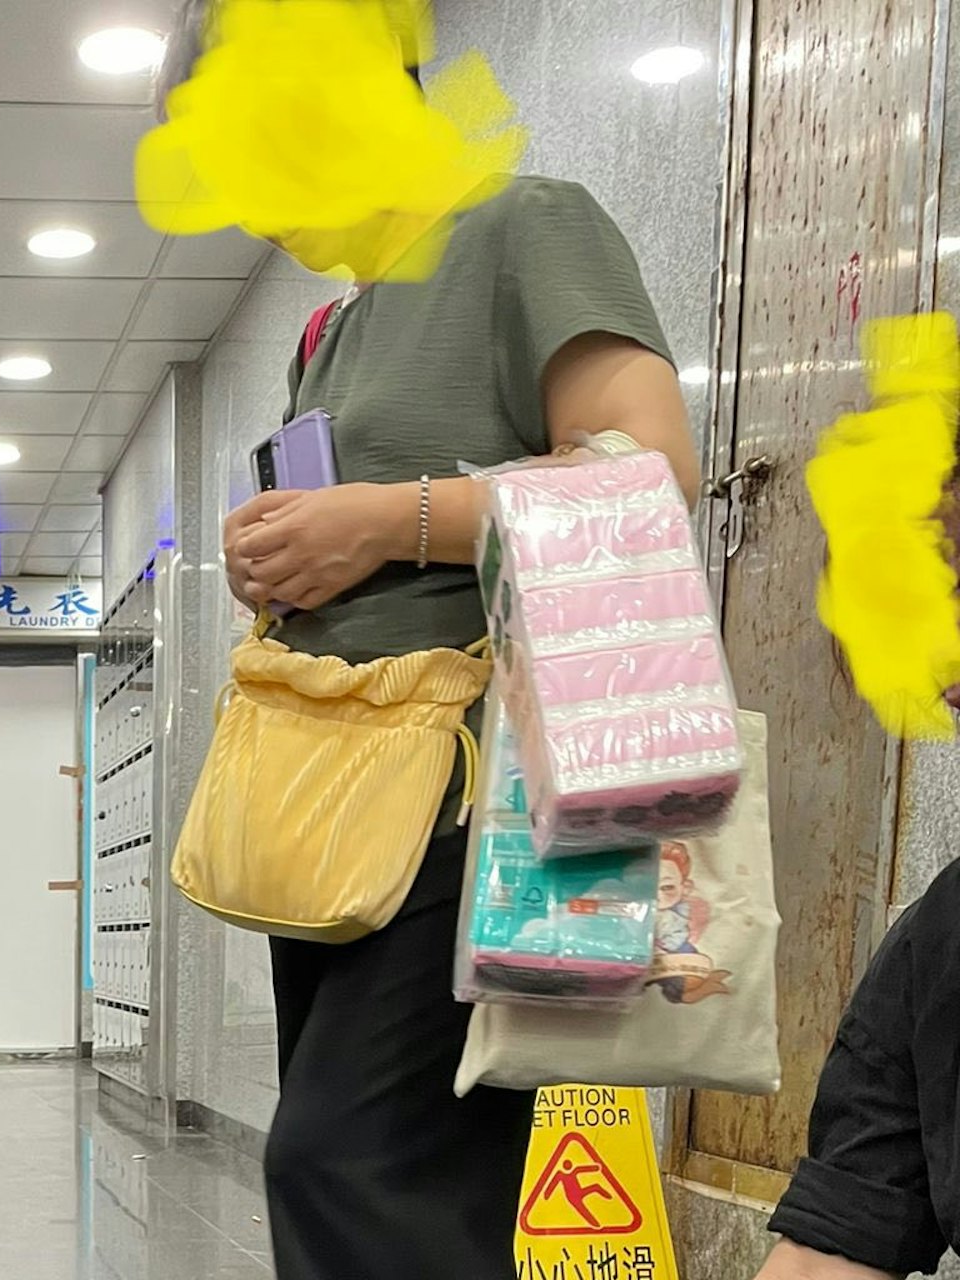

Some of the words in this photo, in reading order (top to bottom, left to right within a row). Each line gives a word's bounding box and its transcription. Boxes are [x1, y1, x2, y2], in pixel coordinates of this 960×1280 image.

[9, 616, 79, 627] LAUNDRY
[537, 1088, 616, 1107] AUTION
[533, 1109, 557, 1128] ET
[562, 1108, 630, 1127] FLOOR
